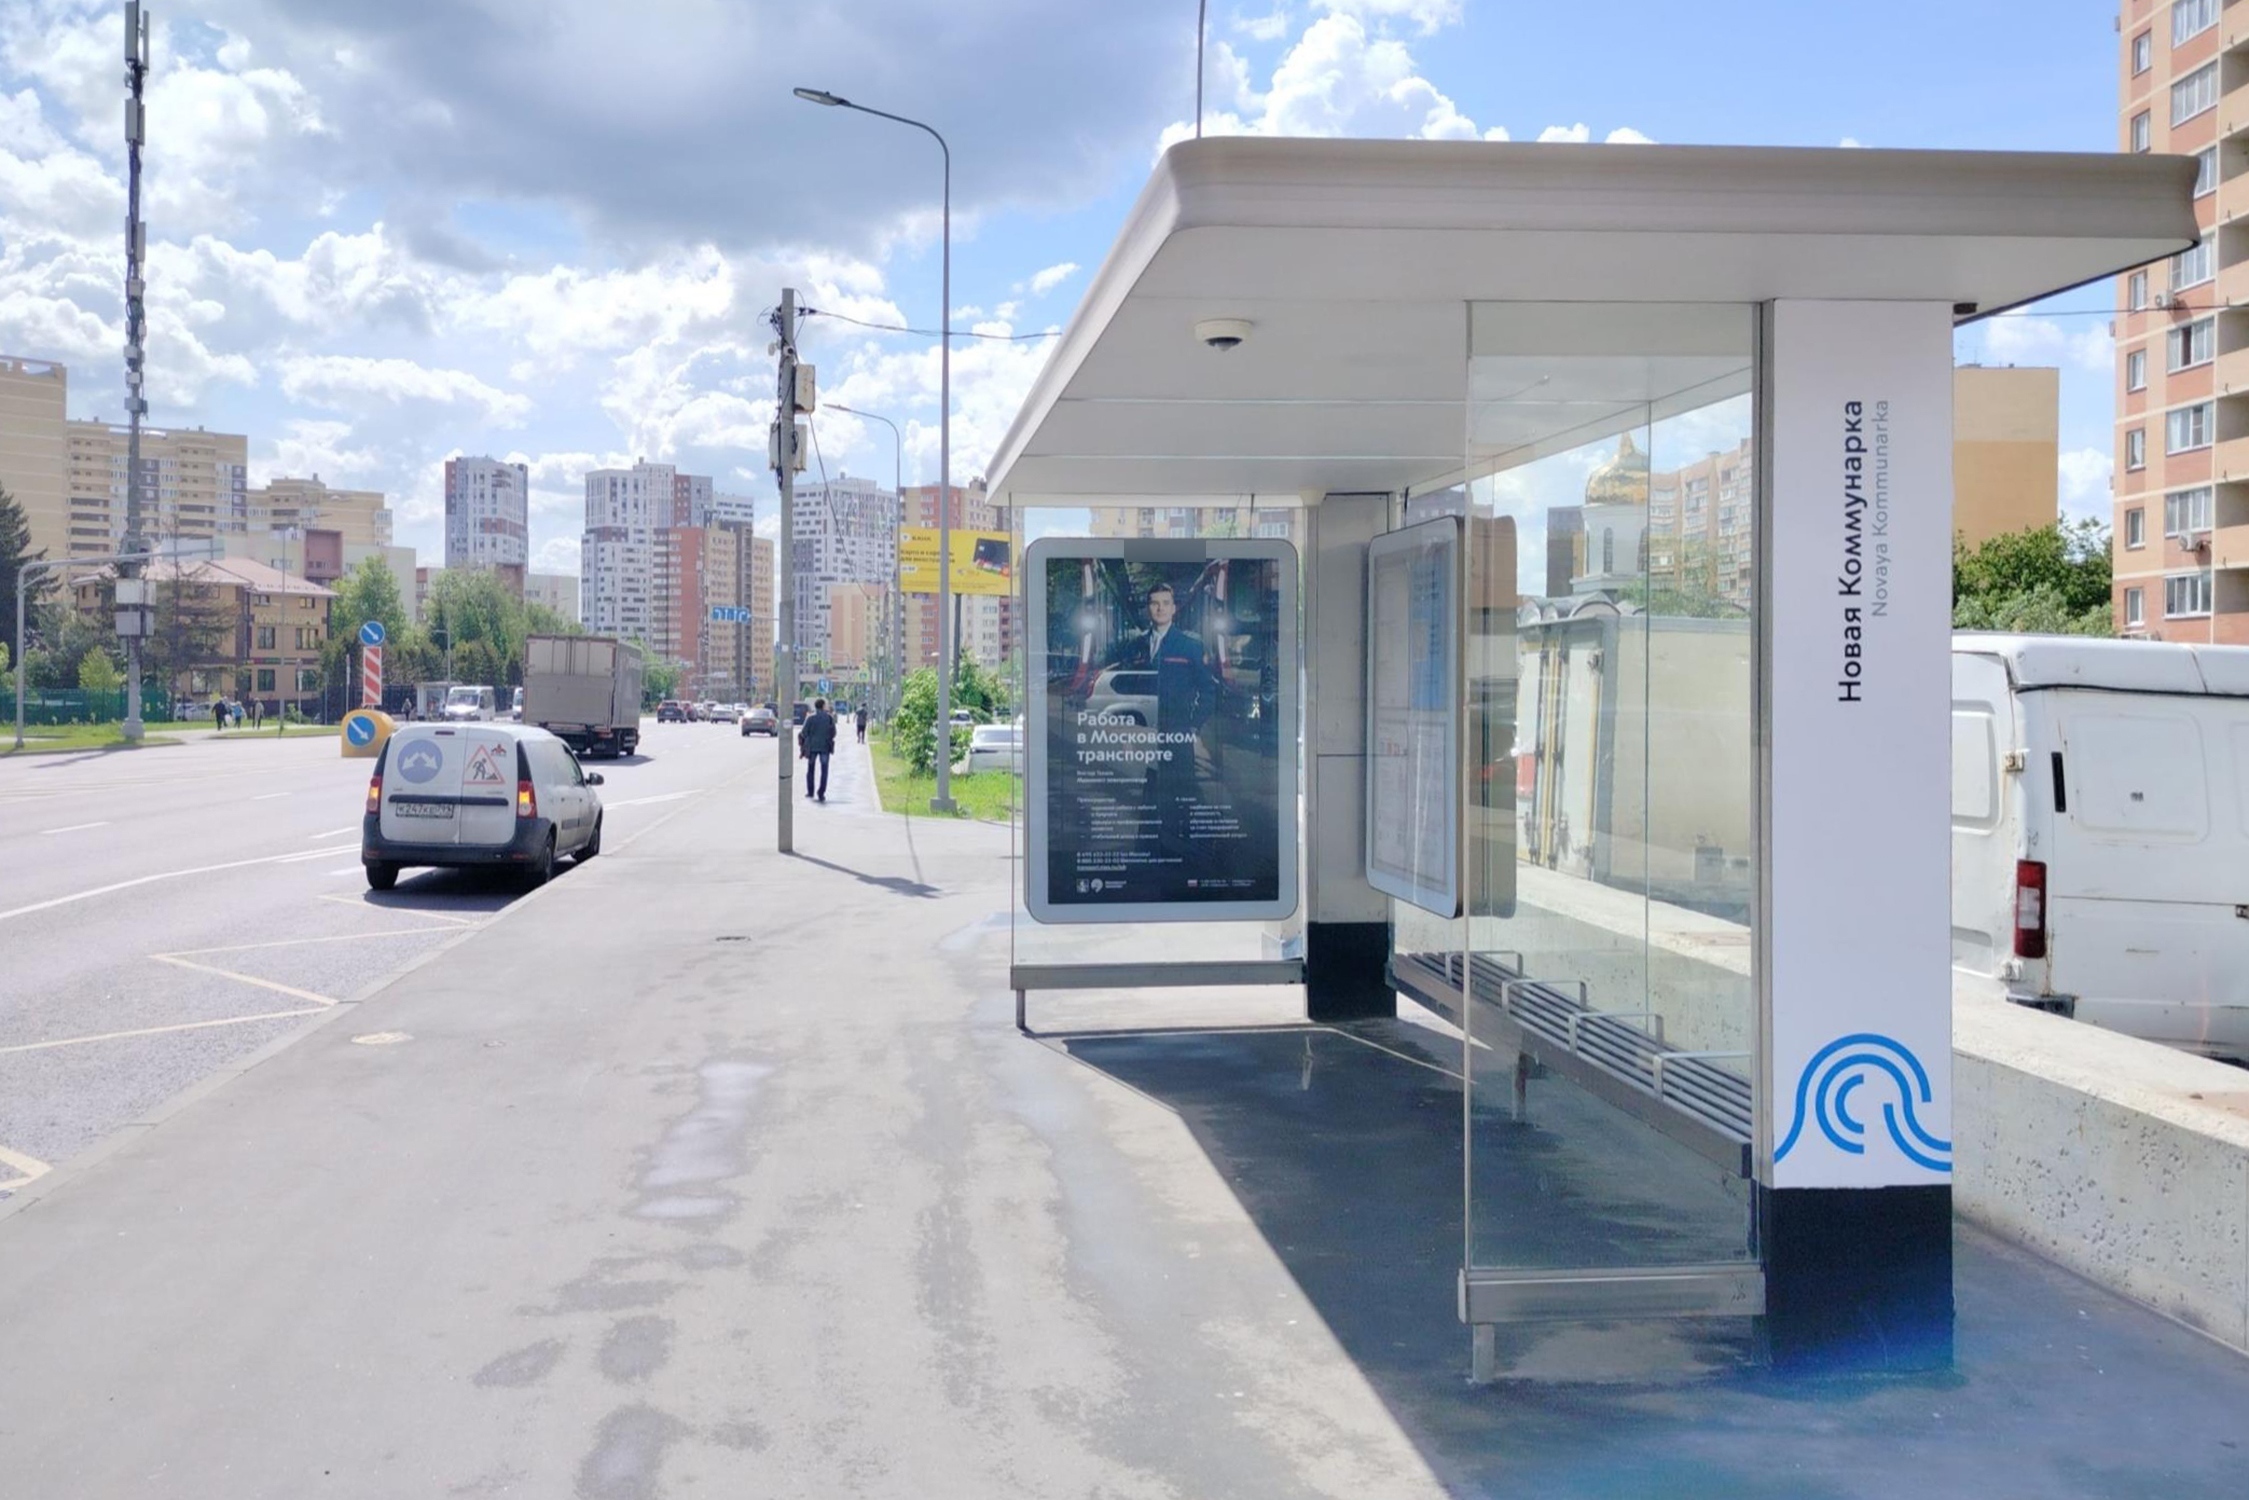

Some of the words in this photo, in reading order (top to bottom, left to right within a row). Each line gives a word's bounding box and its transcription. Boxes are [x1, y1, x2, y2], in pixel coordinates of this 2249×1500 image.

[1838, 400, 1867, 595] Коммунарка
[1871, 400, 1888, 536] Kommunarka
[1872, 542, 1891, 617] Novaya
[1838, 607, 1861, 702] Новая
[1077, 711, 1136, 726] Работа
[1077, 733, 1086, 744] в
[1090, 730, 1197, 744] Московском
[1076, 750, 1173, 764] транспорте
